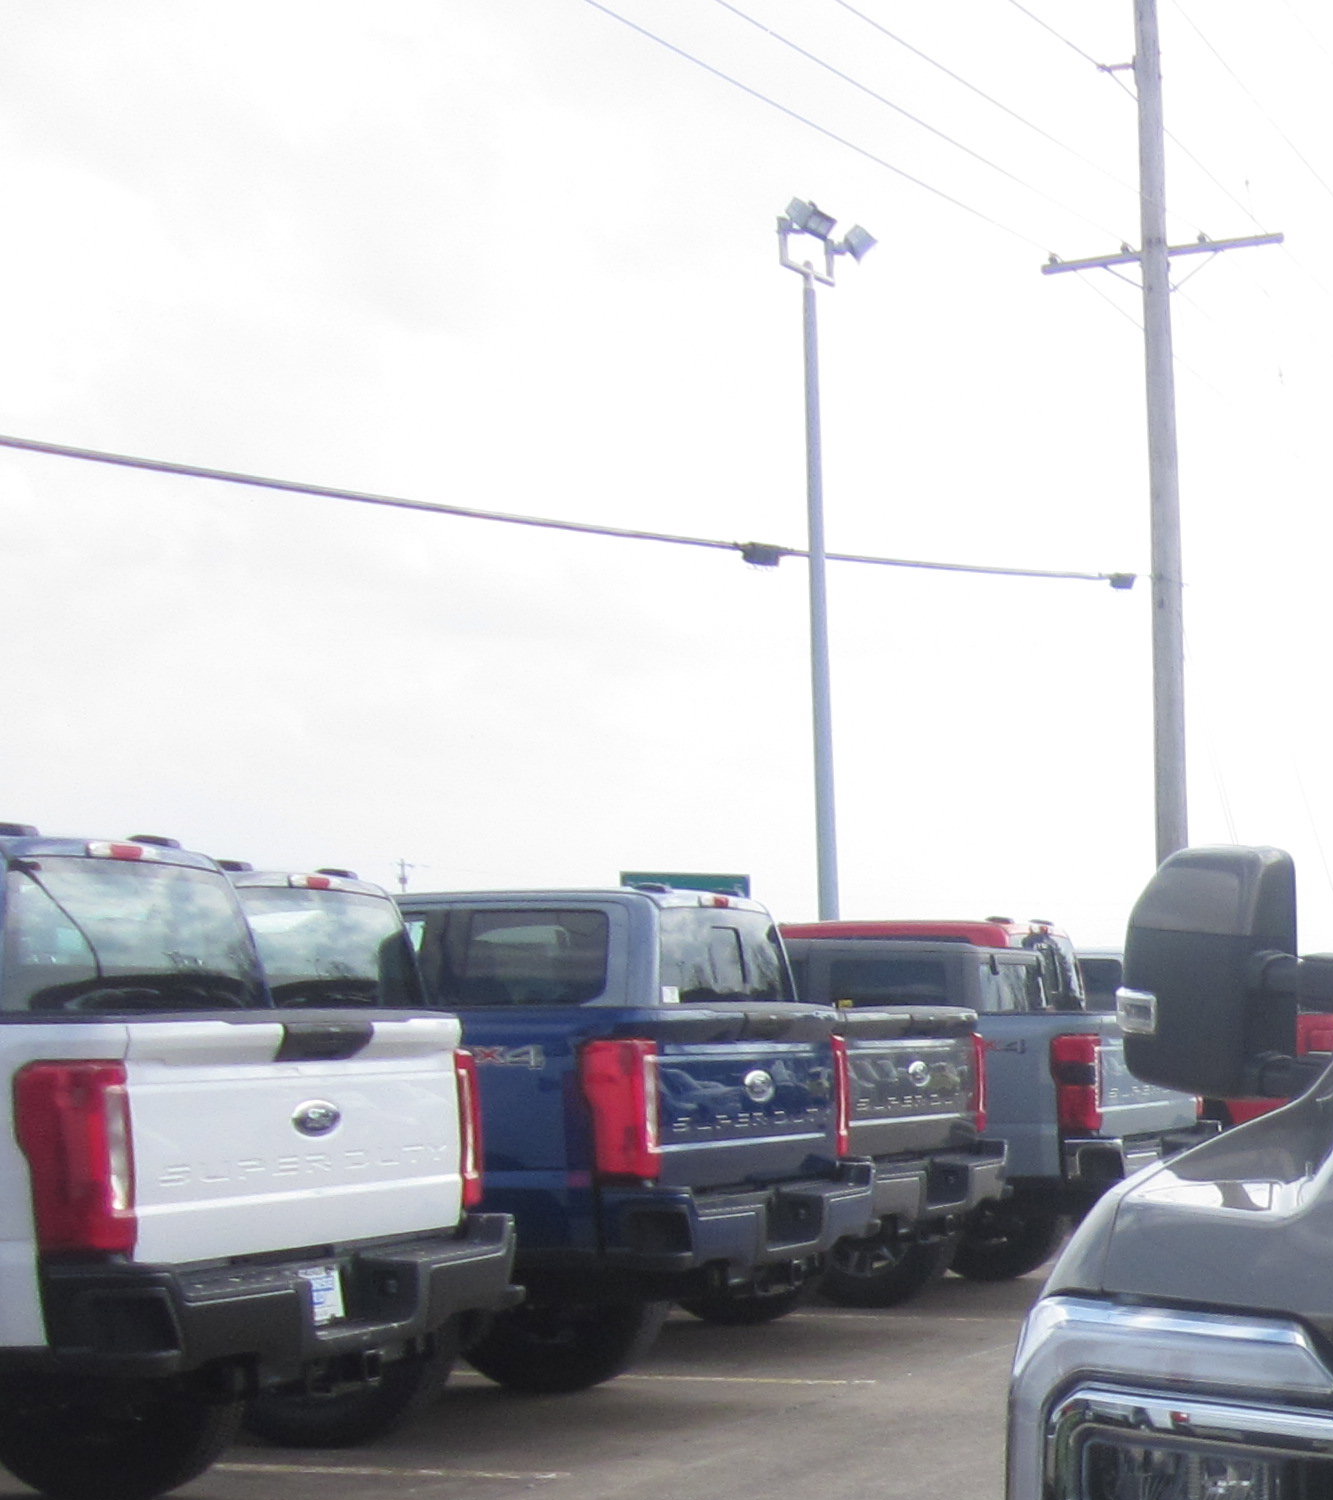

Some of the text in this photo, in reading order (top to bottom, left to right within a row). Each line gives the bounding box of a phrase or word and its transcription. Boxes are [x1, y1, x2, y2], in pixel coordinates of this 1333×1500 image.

[473, 1044, 544, 1070] X4
[672, 1110, 768, 1133] SUPER
[158, 1153, 332, 1188] SUPER
